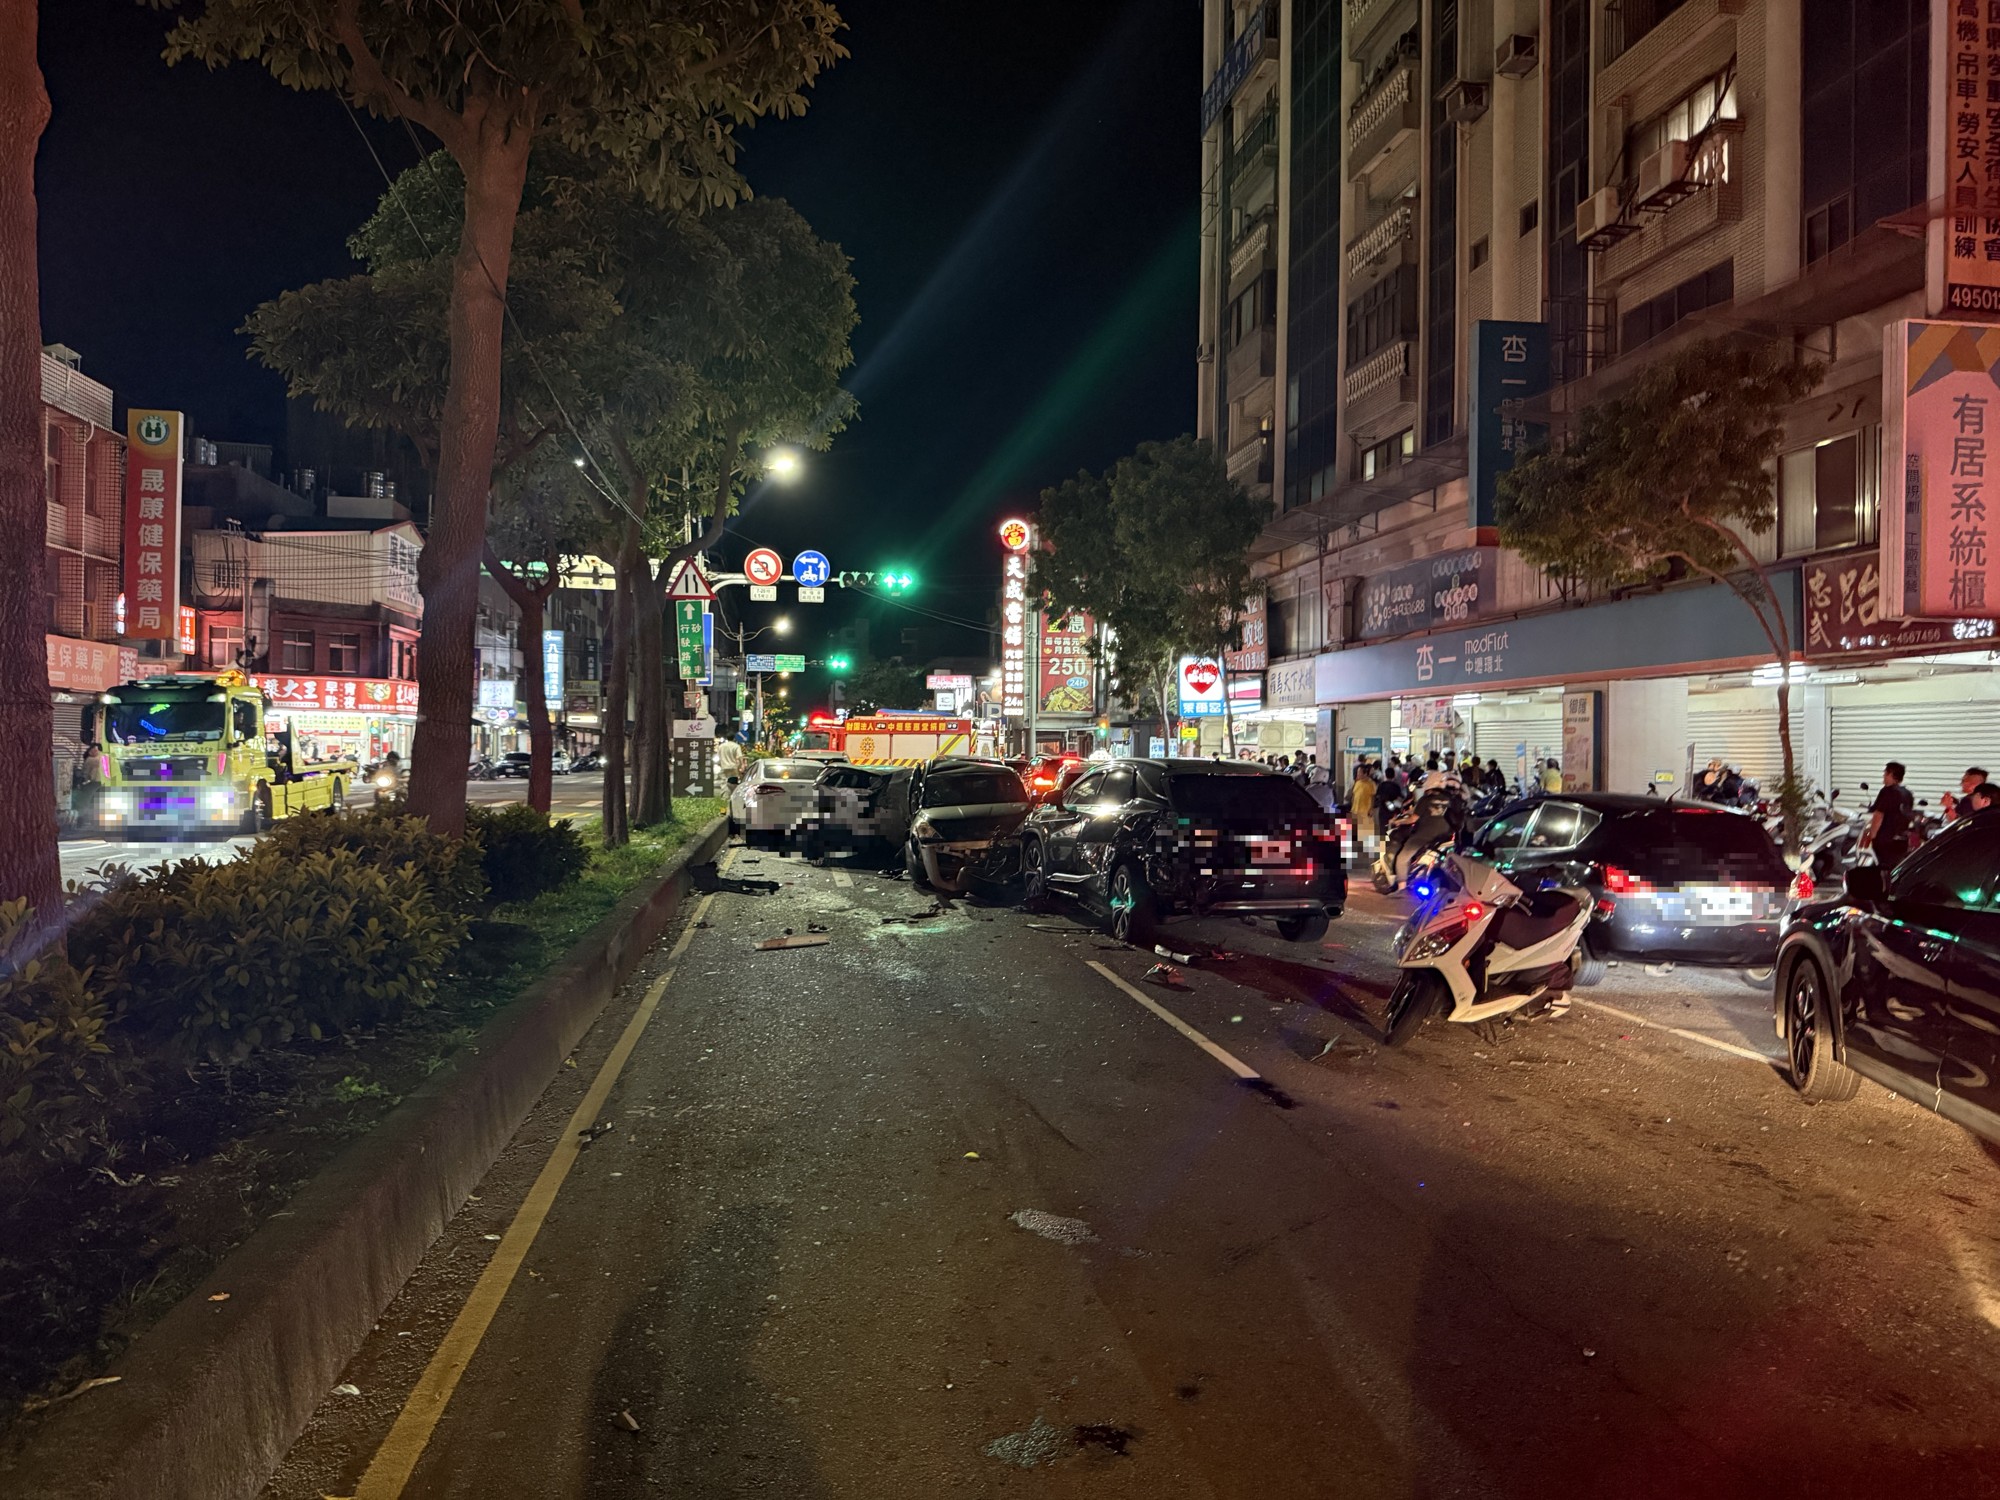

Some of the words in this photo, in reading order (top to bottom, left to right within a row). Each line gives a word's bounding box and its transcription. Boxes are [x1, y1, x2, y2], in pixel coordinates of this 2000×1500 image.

[1502, 334, 1527, 385] 杏一
[1948, 393, 1989, 611] 有居系統櫃
[137, 468, 165, 630] 晟康健保藥局
[1465, 632, 1508, 655] medFirst
[1048, 658, 1086, 675] 250
[1416, 644, 1457, 681] 杏一
[1005, 697, 1023, 706] 24H
